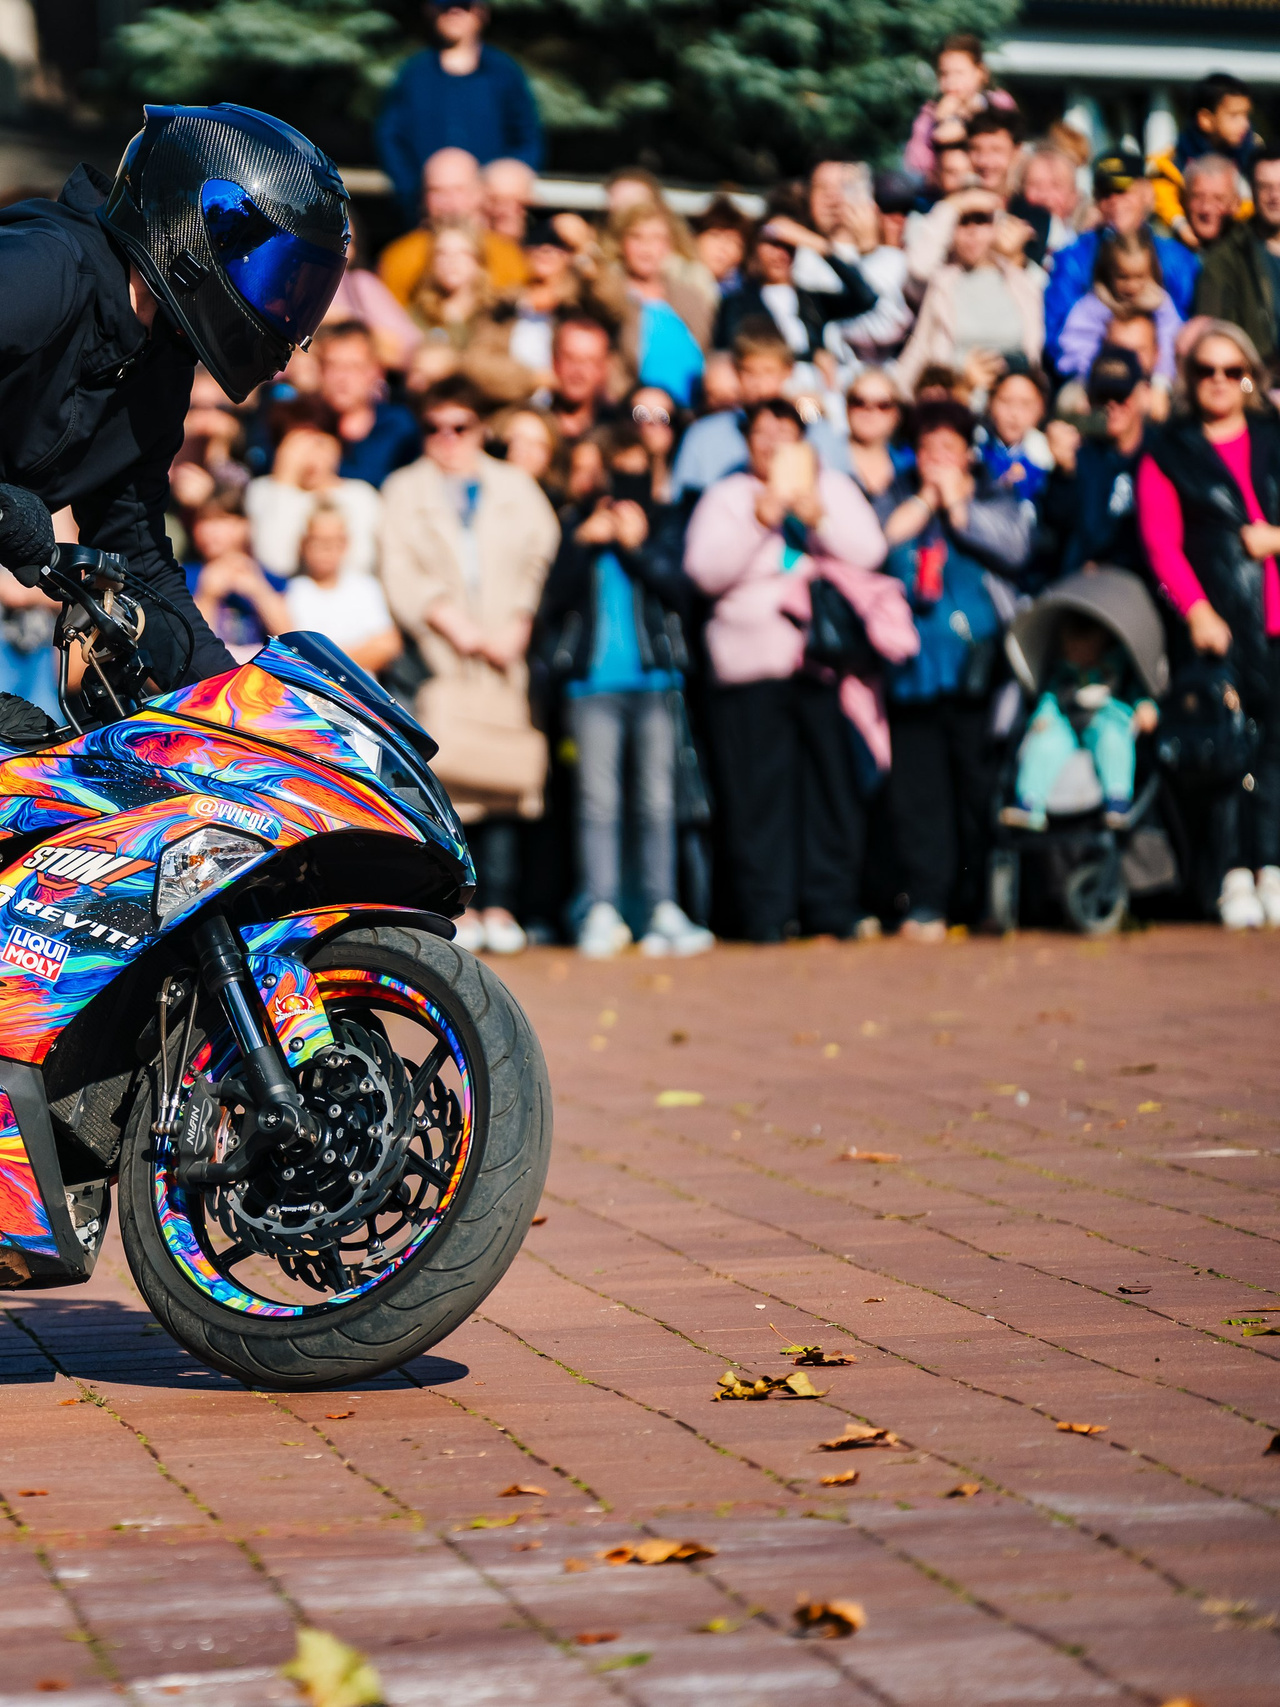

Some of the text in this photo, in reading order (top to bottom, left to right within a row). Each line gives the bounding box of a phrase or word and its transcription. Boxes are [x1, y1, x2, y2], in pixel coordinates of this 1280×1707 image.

[14, 898, 139, 950] REV'IT!
[5, 945, 60, 978] MOLY
[12, 928, 66, 962] LIQUI
